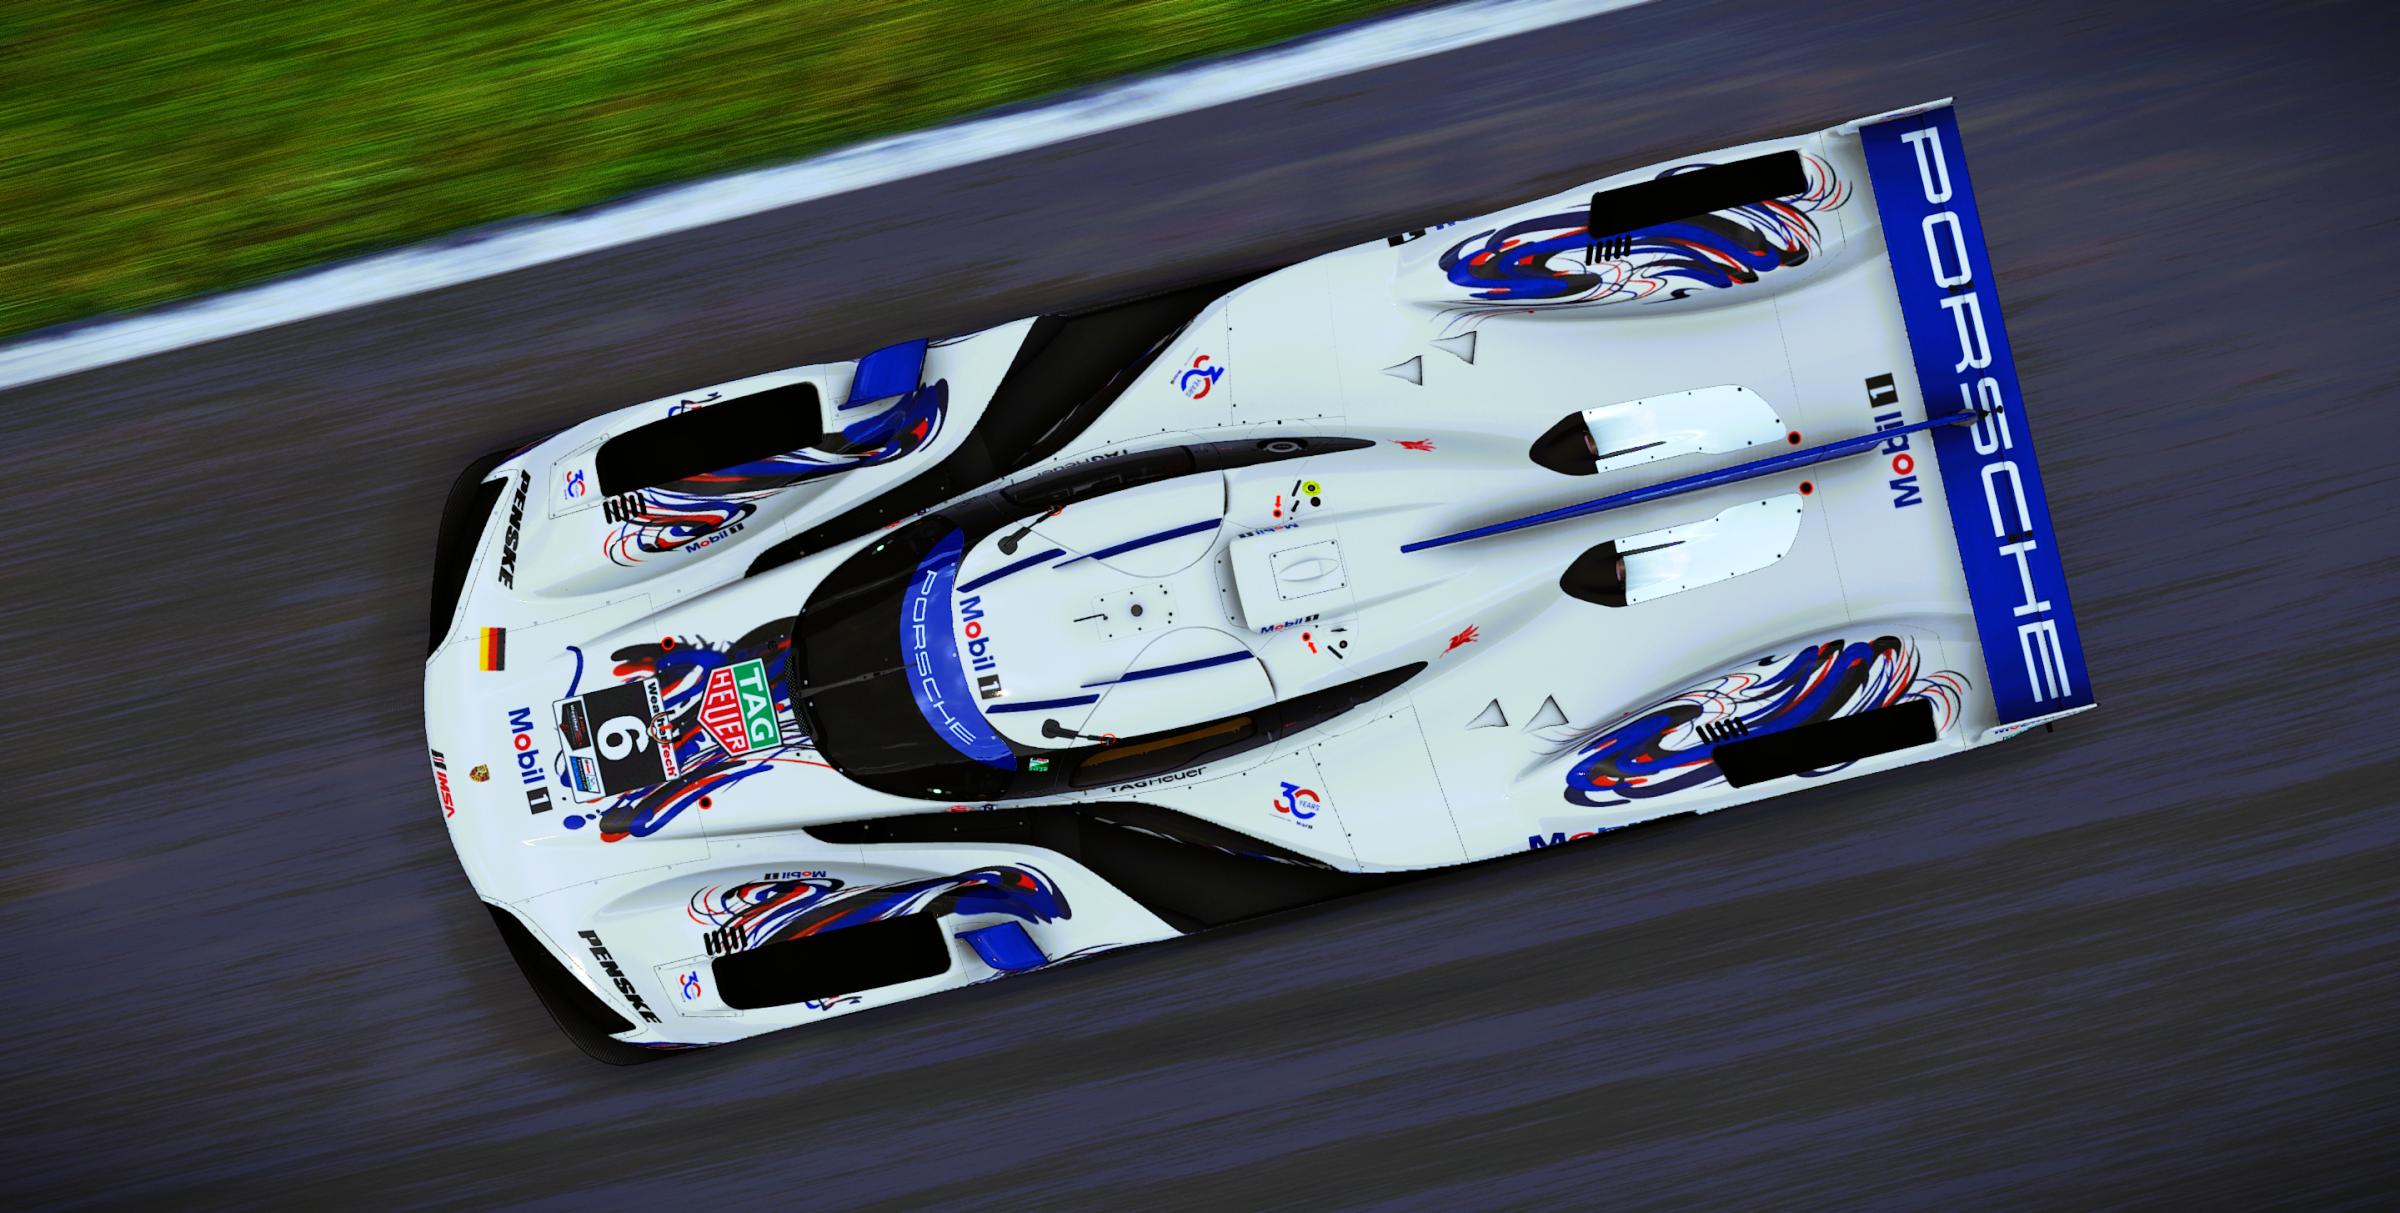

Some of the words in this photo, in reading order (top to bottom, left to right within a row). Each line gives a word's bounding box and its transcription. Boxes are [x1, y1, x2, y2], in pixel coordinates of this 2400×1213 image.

[1901, 127, 2072, 703] PORSCHE
[1874, 411, 1923, 509] Mobil
[498, 469, 531, 591] PENSKE
[685, 530, 729, 553] Mobil
[912, 570, 977, 746] PORSCHE
[959, 595, 996, 672] Mobil
[1260, 617, 1303, 635] Mobil
[596, 715, 650, 761] 6
[646, 681, 677, 777] WeaherTech
[703, 671, 747, 751] HEUER
[739, 666, 774, 743] TAG
[508, 706, 546, 785] Mobil
[1105, 766, 1208, 793] TAGHeuer
[436, 770, 456, 818] IMSA
[1273, 781, 1321, 820] 30
[781, 870, 827, 880] Mobil
[577, 929, 663, 1024] PENSKE
